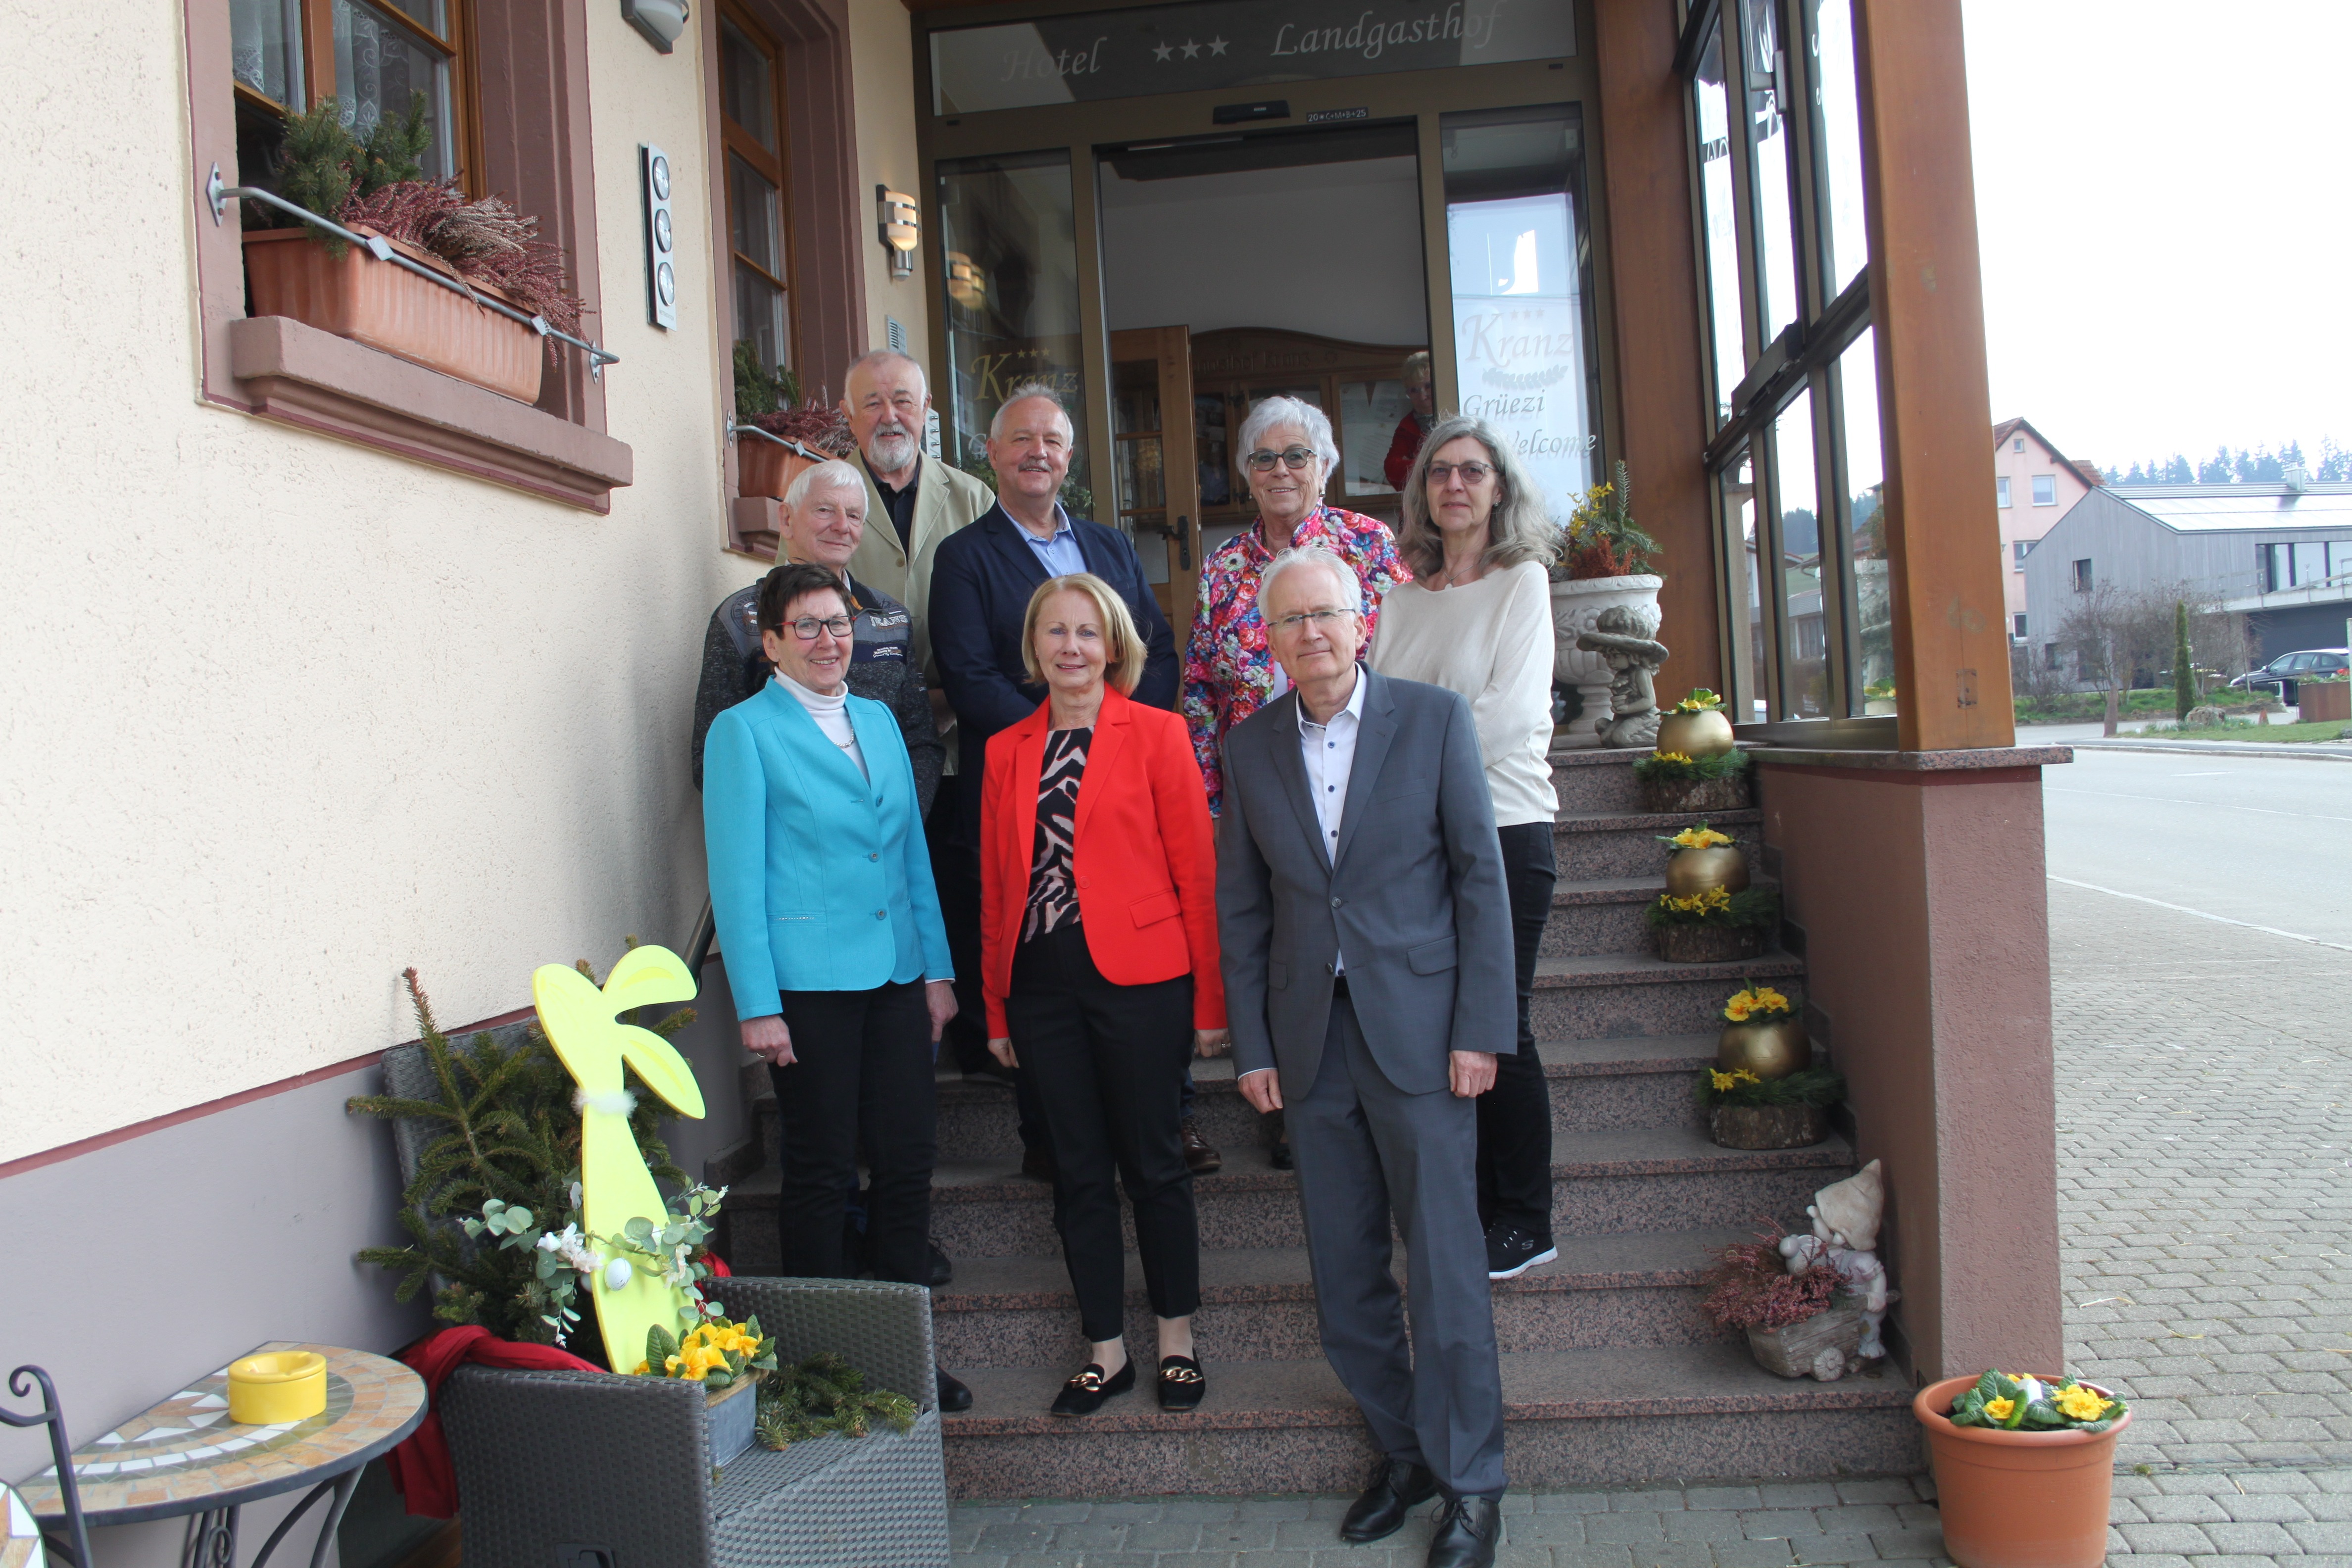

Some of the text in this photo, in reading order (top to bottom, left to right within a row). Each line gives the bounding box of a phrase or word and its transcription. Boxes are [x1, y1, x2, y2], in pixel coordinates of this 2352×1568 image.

[1000, 1, 1502, 83] Hotel Landgasthof
[1462, 312, 1574, 368] Kranz
[1463, 389, 1546, 417] Grüezi
[1514, 429, 1597, 455] elcome
